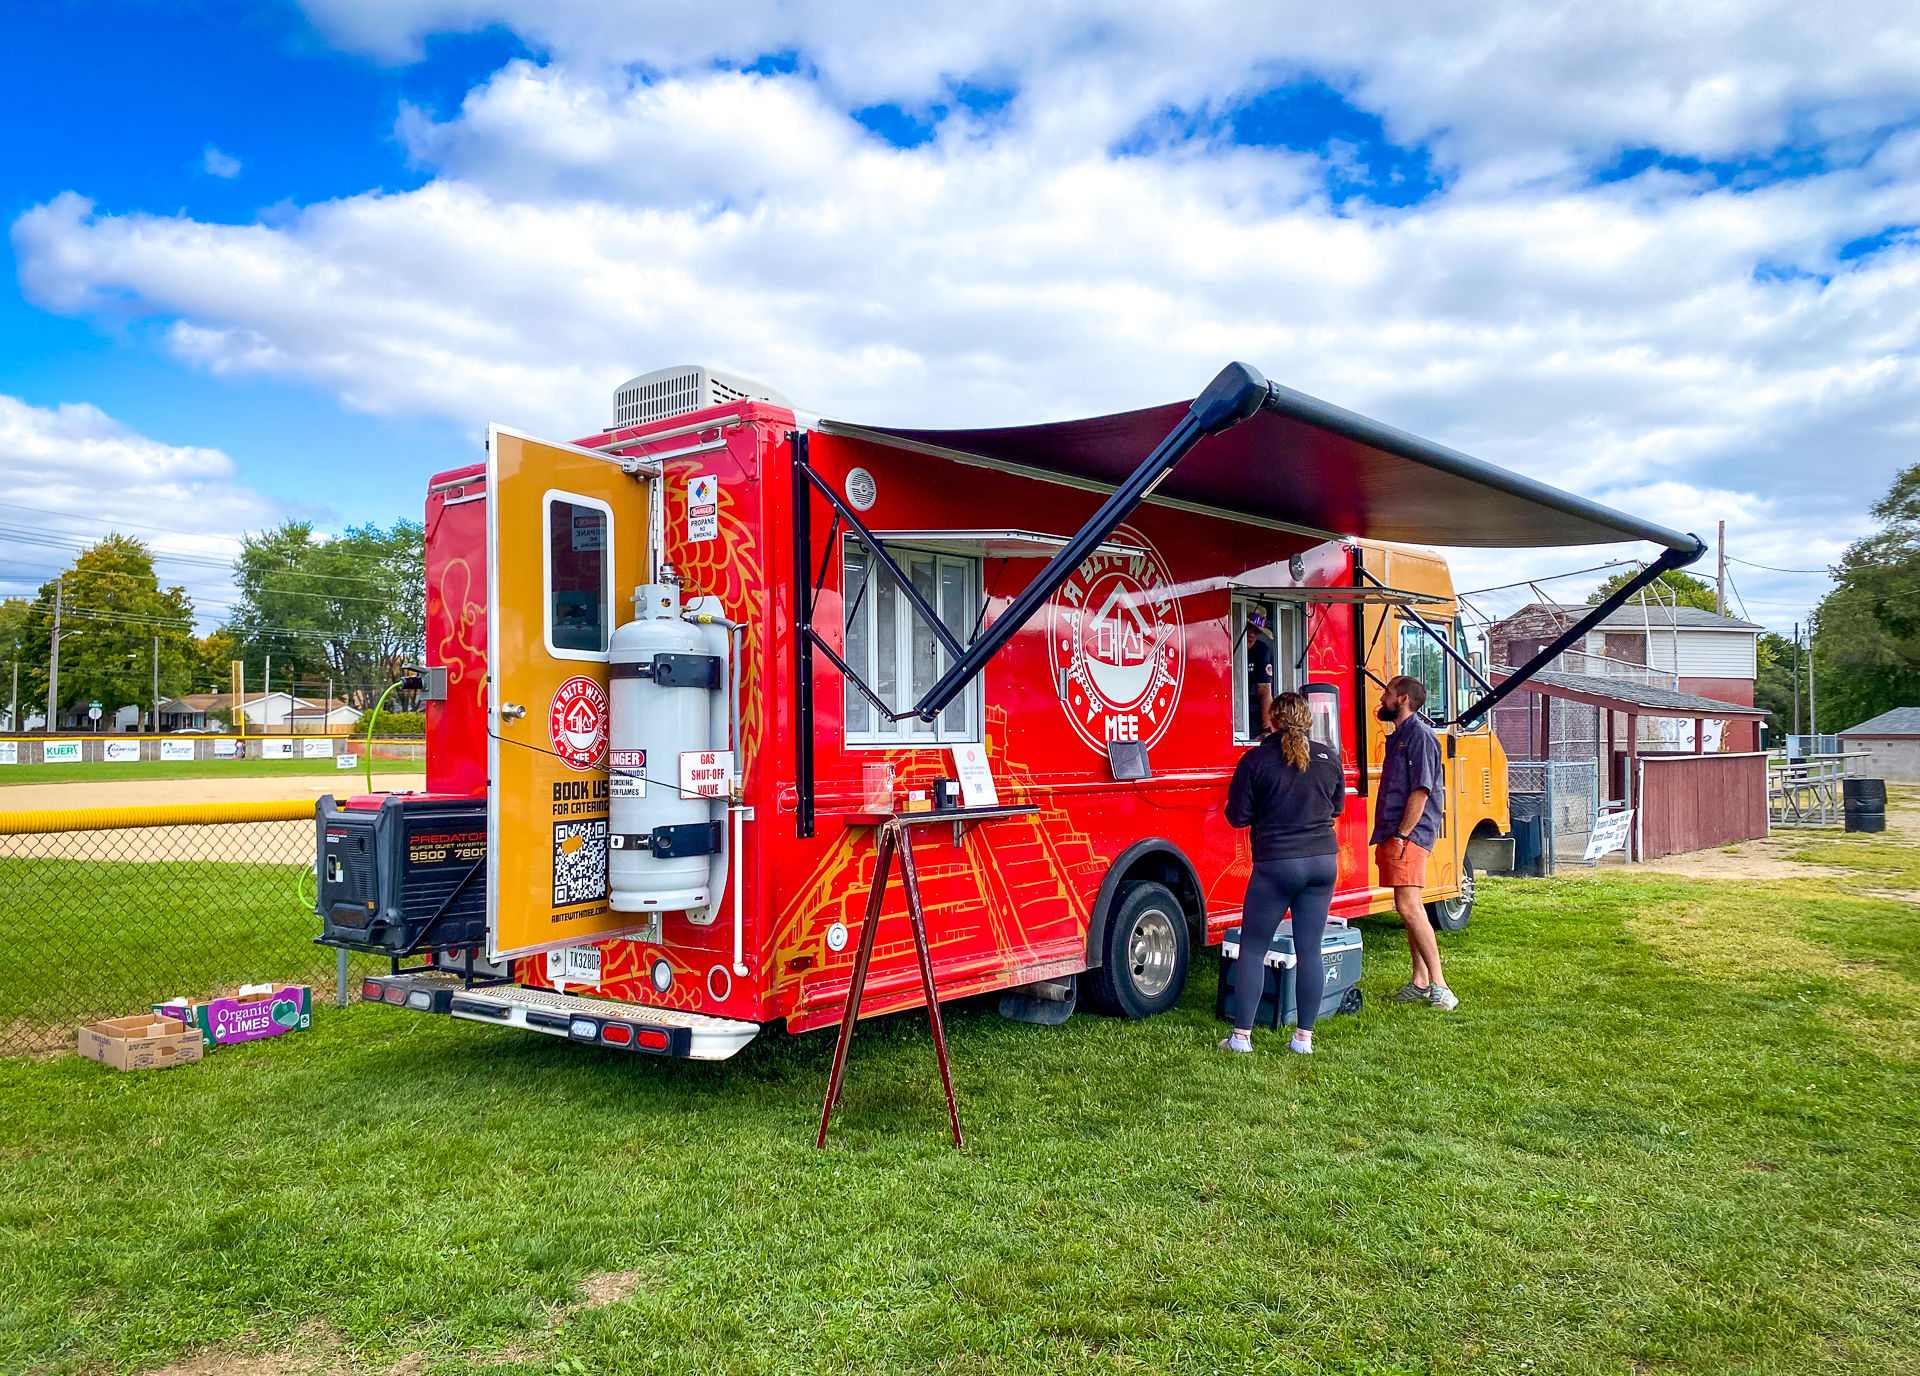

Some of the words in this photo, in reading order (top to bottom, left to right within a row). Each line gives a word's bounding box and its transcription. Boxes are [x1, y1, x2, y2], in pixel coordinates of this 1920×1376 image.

[691, 518, 714, 527] PROPANE
[693, 531, 712, 539] SMOKING
[1063, 579, 1083, 607] A
[555, 700, 565, 712] A
[561, 682, 583, 701] BITE
[585, 683, 606, 713] WITH
[1104, 713, 1139, 742] MEE
[46, 743, 79, 756] KUERT
[573, 752, 590, 766] MEE
[700, 753, 715, 765] GAS
[691, 768, 725, 781] SHUT-OFF
[553, 781, 589, 801] BOOK
[592, 780, 609, 799] US
[619, 788, 640, 796] FLAMES
[697, 784, 719, 795] VALVE
[552, 803, 569, 816] FOR
[571, 799, 609, 814] CATERING
[410, 850, 447, 861] 9500
[218, 1003, 269, 1023] Organic
[229, 1016, 270, 1034] LIMES
